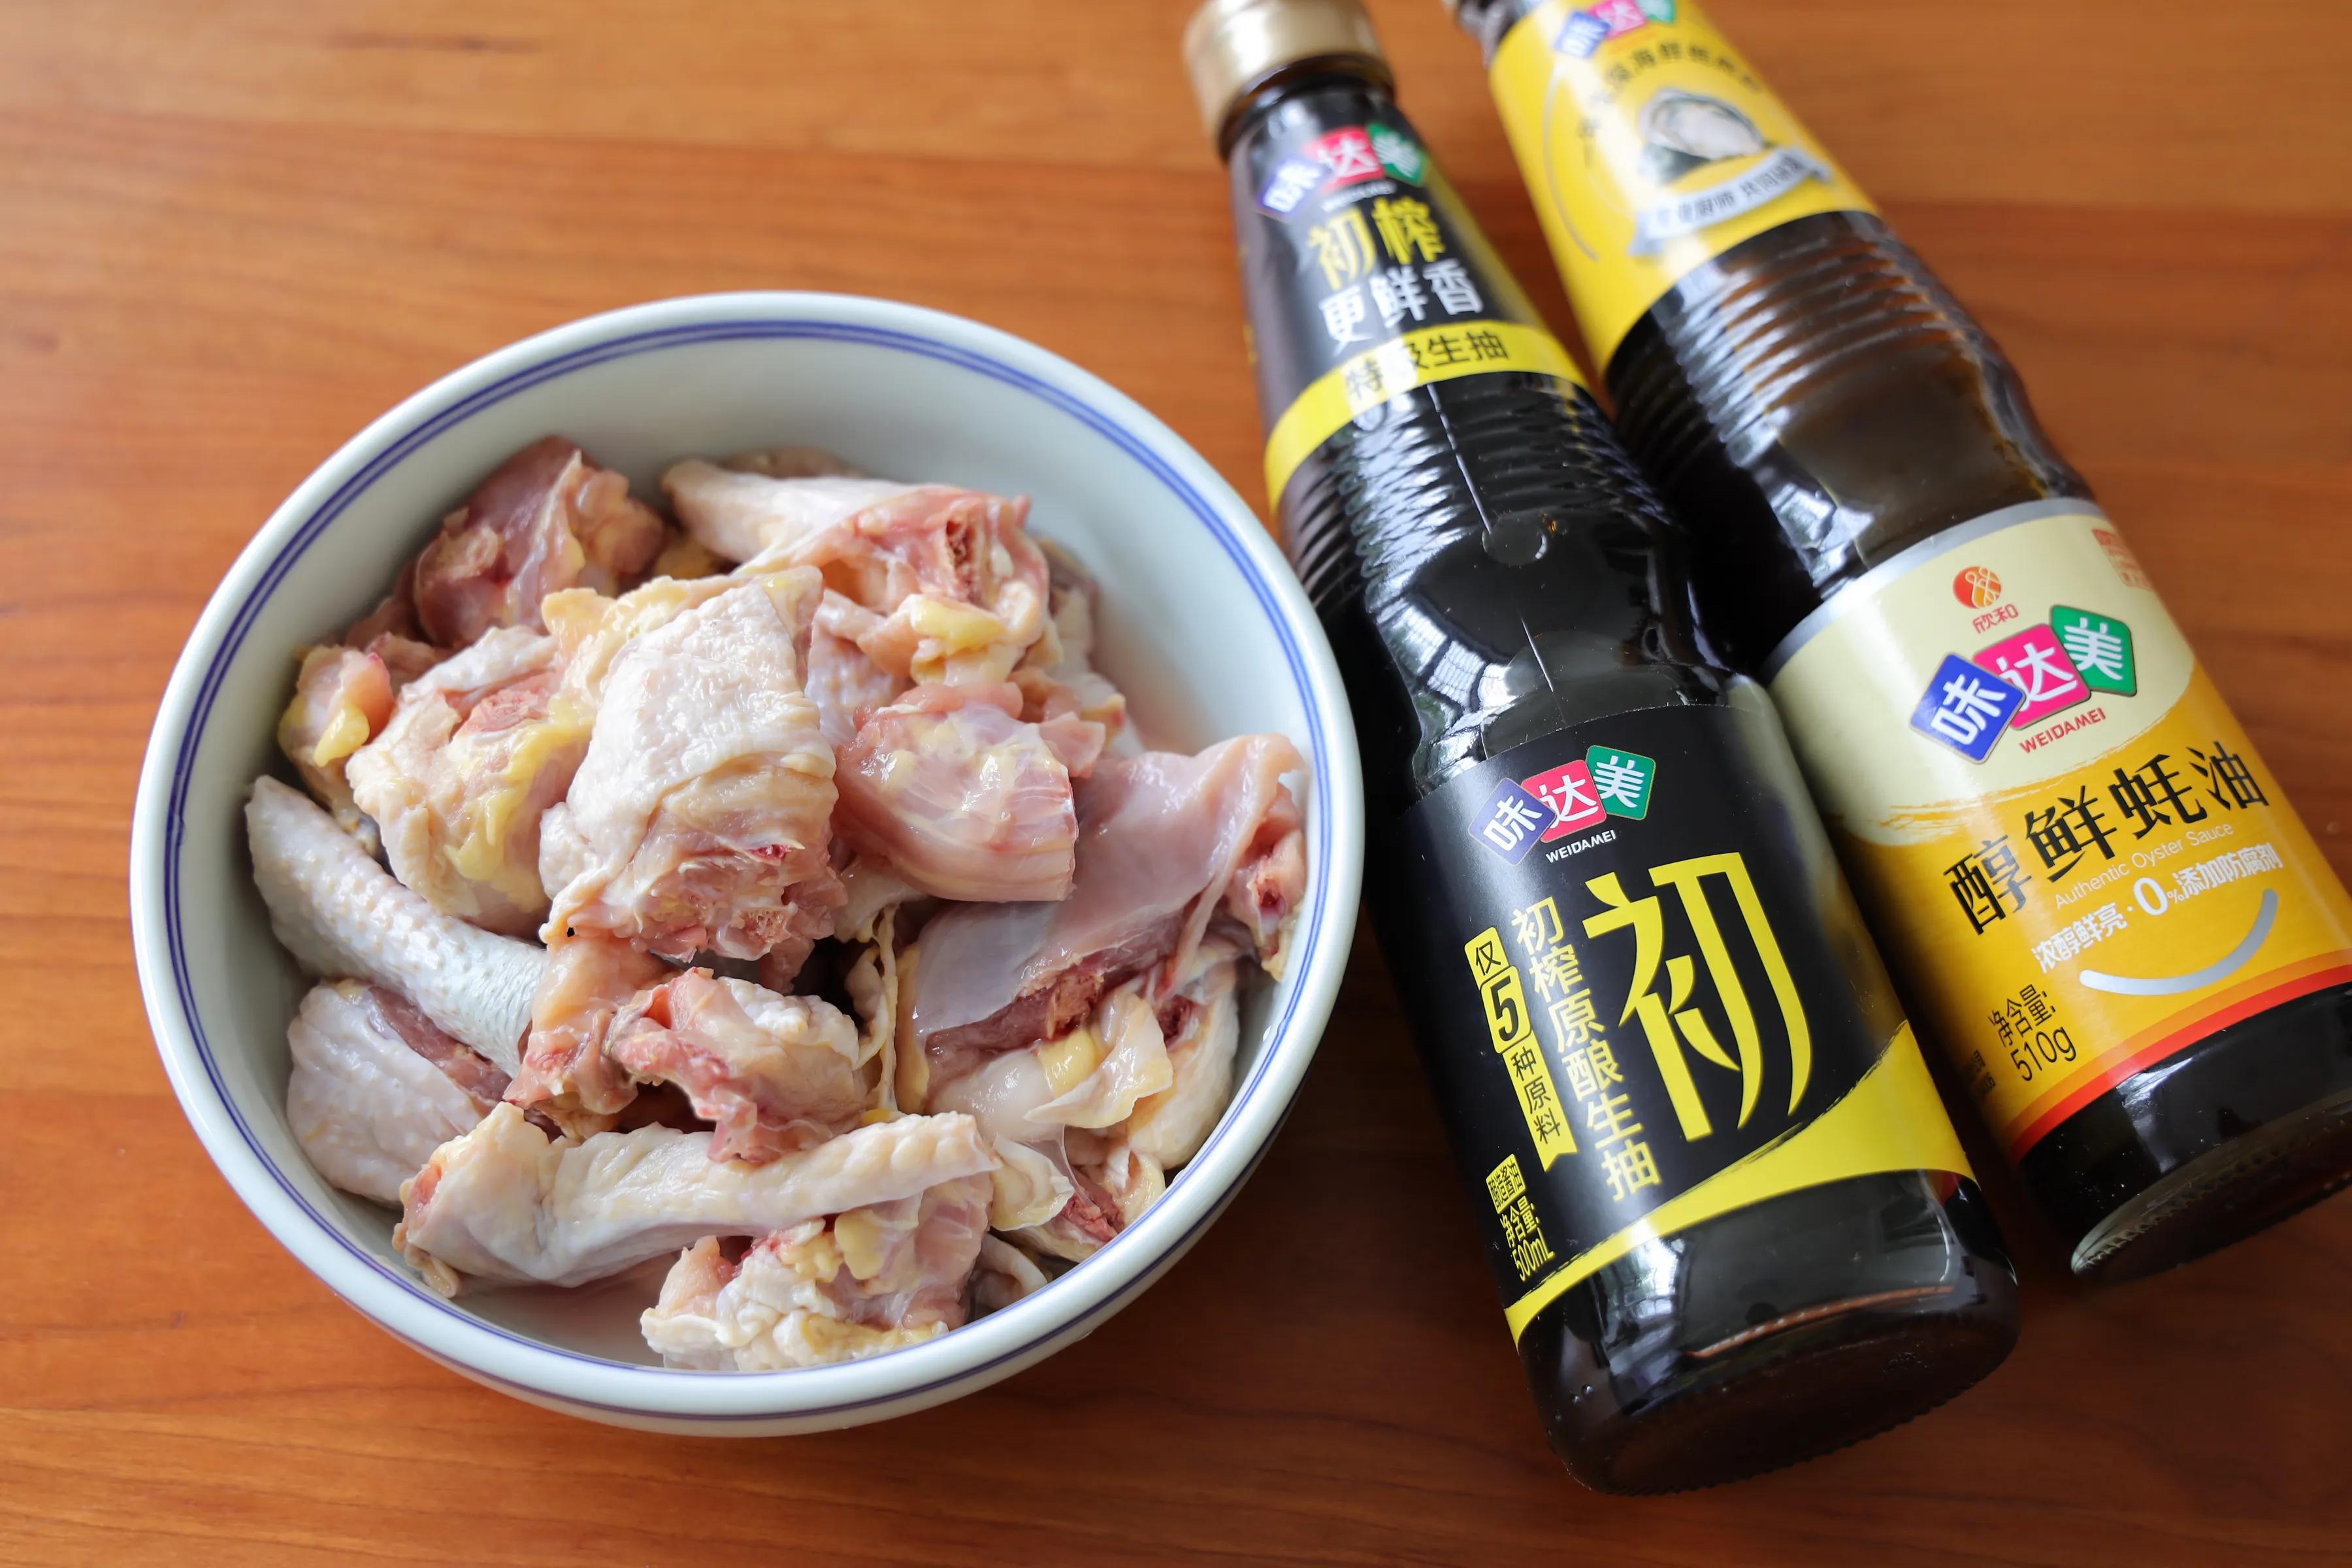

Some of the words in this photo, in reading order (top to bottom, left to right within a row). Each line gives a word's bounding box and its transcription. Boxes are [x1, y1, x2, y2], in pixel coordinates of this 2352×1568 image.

[1309, 196, 1446, 291] 初榨
[1319, 258, 1483, 357] 更鲜香
[1972, 603, 2019, 634] 欣和
[1930, 617, 2123, 745] 味达美
[2019, 708, 2106, 753] WEIDAMEI
[1483, 755, 1645, 851] 味达美
[1545, 830, 1616, 863] WEIDAMEI
[1944, 741, 2270, 936] 醇鲜蚝油
[2054, 861, 2131, 910] Authentic
[2131, 838, 2184, 868] Oyster
[2185, 821, 2234, 847] Sauce
[1582, 852, 1812, 1143] 初
[1511, 896, 1661, 1203] 初榨原酿生抽
[2010, 1026, 2076, 1082] 510g
[1512, 1227, 1556, 1282] 500mL
